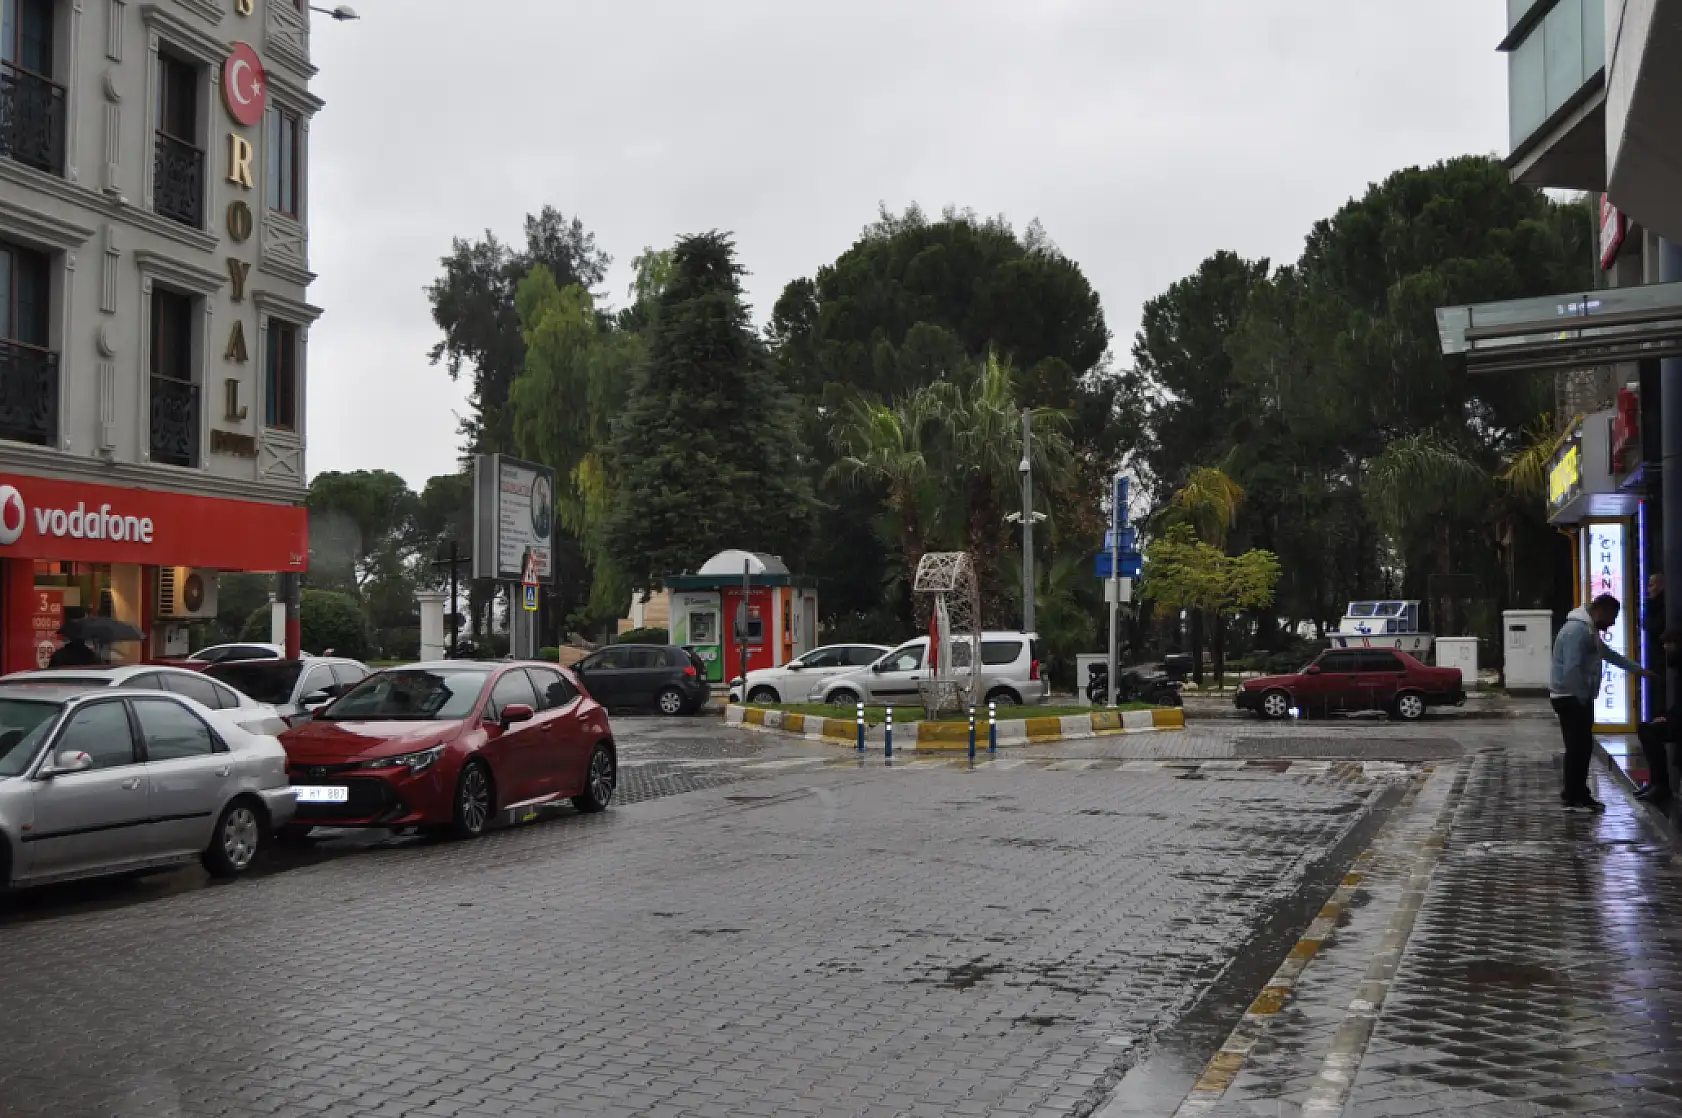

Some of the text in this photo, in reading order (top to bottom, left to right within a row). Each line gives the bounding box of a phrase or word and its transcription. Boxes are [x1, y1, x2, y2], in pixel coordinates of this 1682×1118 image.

[224, 133, 254, 422] ROYAL
[34, 501, 154, 543] vodafone
[40, 594, 48, 612] 3
[1603, 631, 1614, 710] OICE
